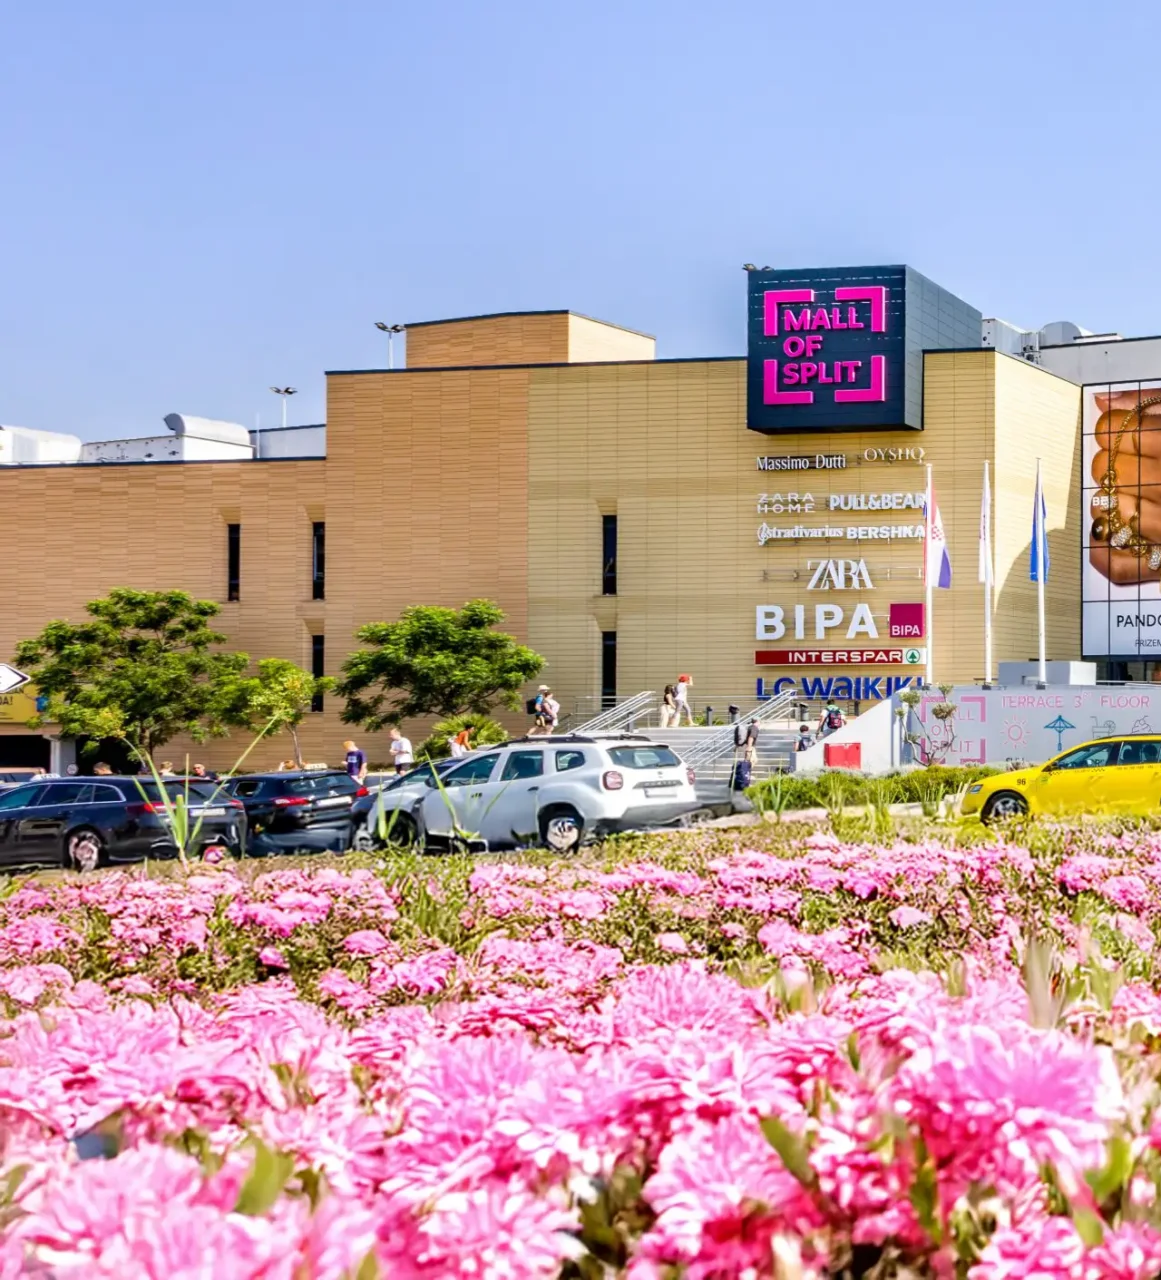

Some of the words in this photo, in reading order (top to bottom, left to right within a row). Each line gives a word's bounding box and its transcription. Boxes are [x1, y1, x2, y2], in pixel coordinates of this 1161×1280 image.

[784, 307, 864, 331] MALL
[782, 335, 823, 357] OF
[782, 360, 861, 384] SPLIT
[756, 456, 810, 470] Massimo
[815, 454, 846, 469] Dutti
[864, 447, 925, 461] OYSHO
[757, 492, 815, 503] ZARA
[829, 492, 926, 510] PULL&BEAR
[757, 503, 816, 513] HOME
[846, 525, 925, 539] BERSHKA
[807, 558, 877, 590] ZARA
[755, 604, 879, 640] BIPA
[891, 625, 920, 636] BIPA
[788, 651, 902, 663] INTERSPAR
[757, 677, 797, 700] LC
[1002, 696, 1063, 708] TERRACE
[1100, 695, 1150, 708] FLOOR
